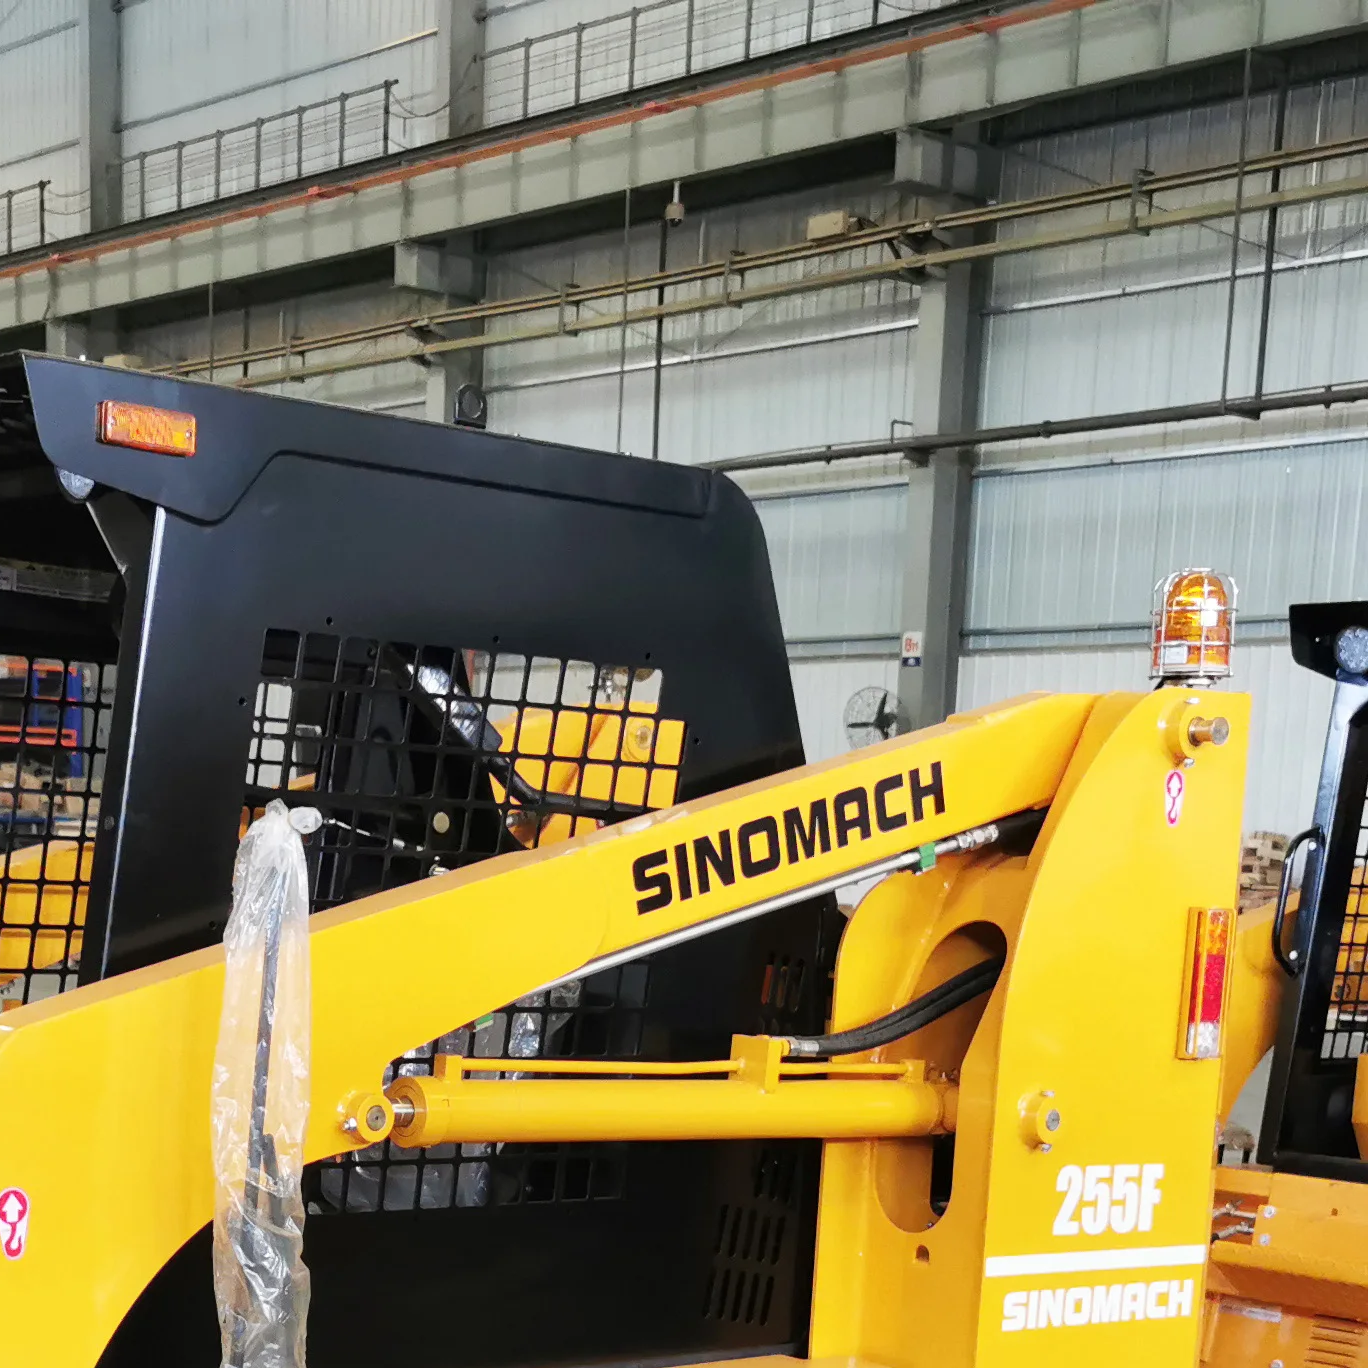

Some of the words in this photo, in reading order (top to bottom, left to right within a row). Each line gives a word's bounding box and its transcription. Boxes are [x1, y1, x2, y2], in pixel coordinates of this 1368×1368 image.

[632, 760, 946, 916] SINOMACH
[1052, 1163, 1165, 1236] 255F
[1001, 1279, 1194, 1332] SINOMACH
